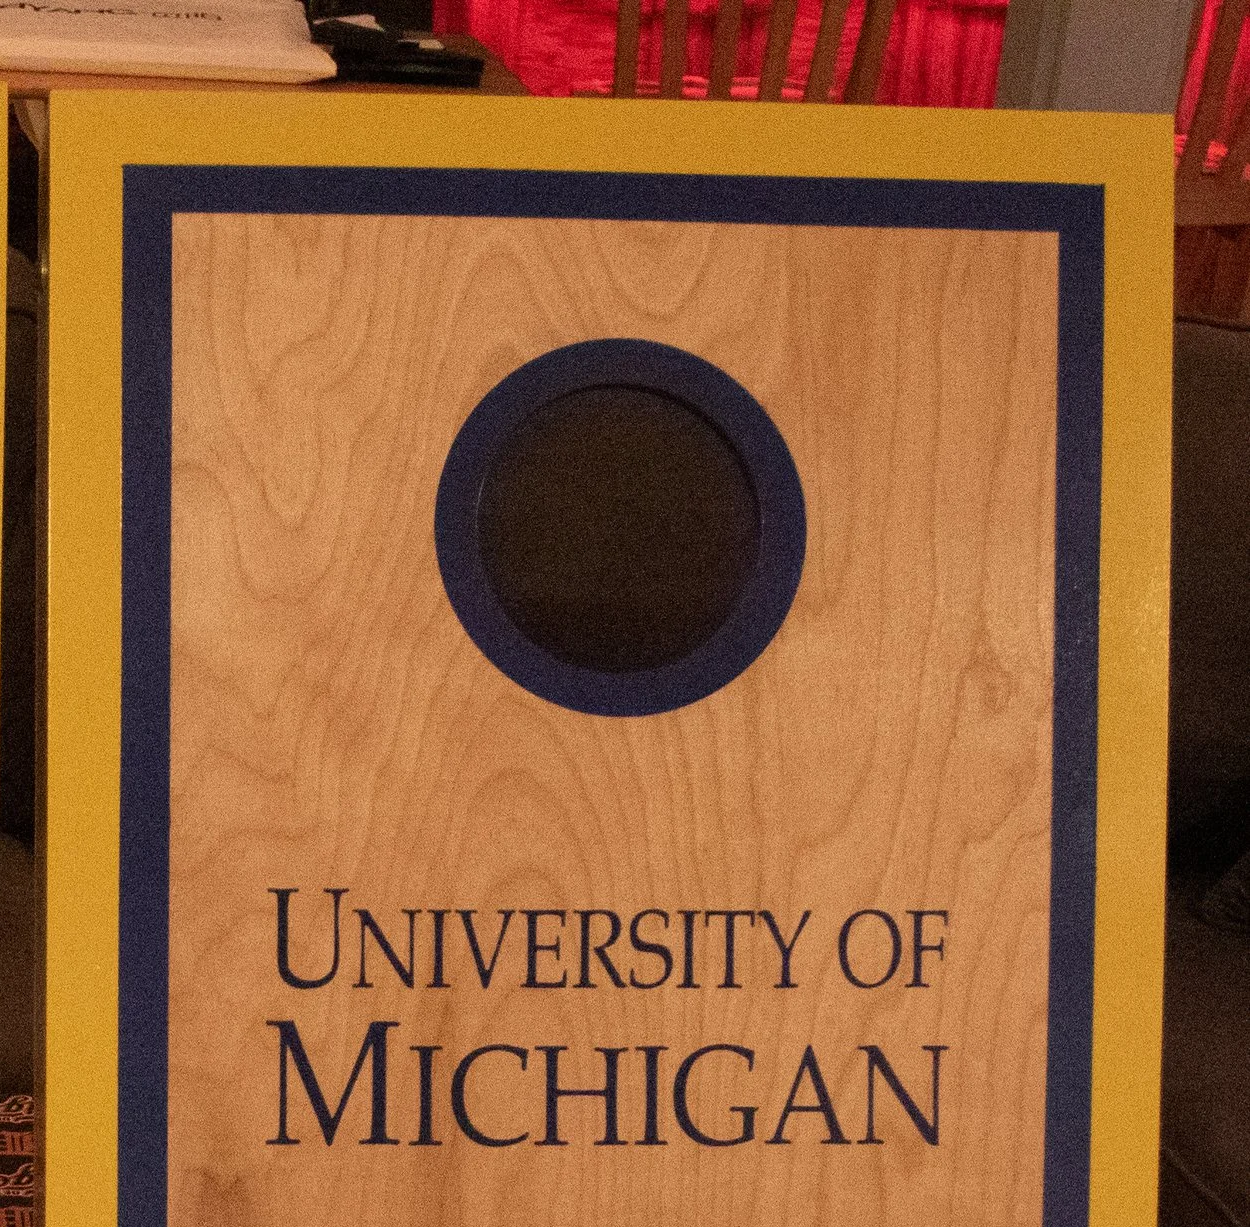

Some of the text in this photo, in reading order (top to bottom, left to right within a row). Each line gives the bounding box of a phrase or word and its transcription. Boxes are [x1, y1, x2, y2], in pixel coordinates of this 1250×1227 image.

[267, 887, 950, 990] UNIVERSITY OF
[265, 1019, 950, 1147] MICHIGAN
